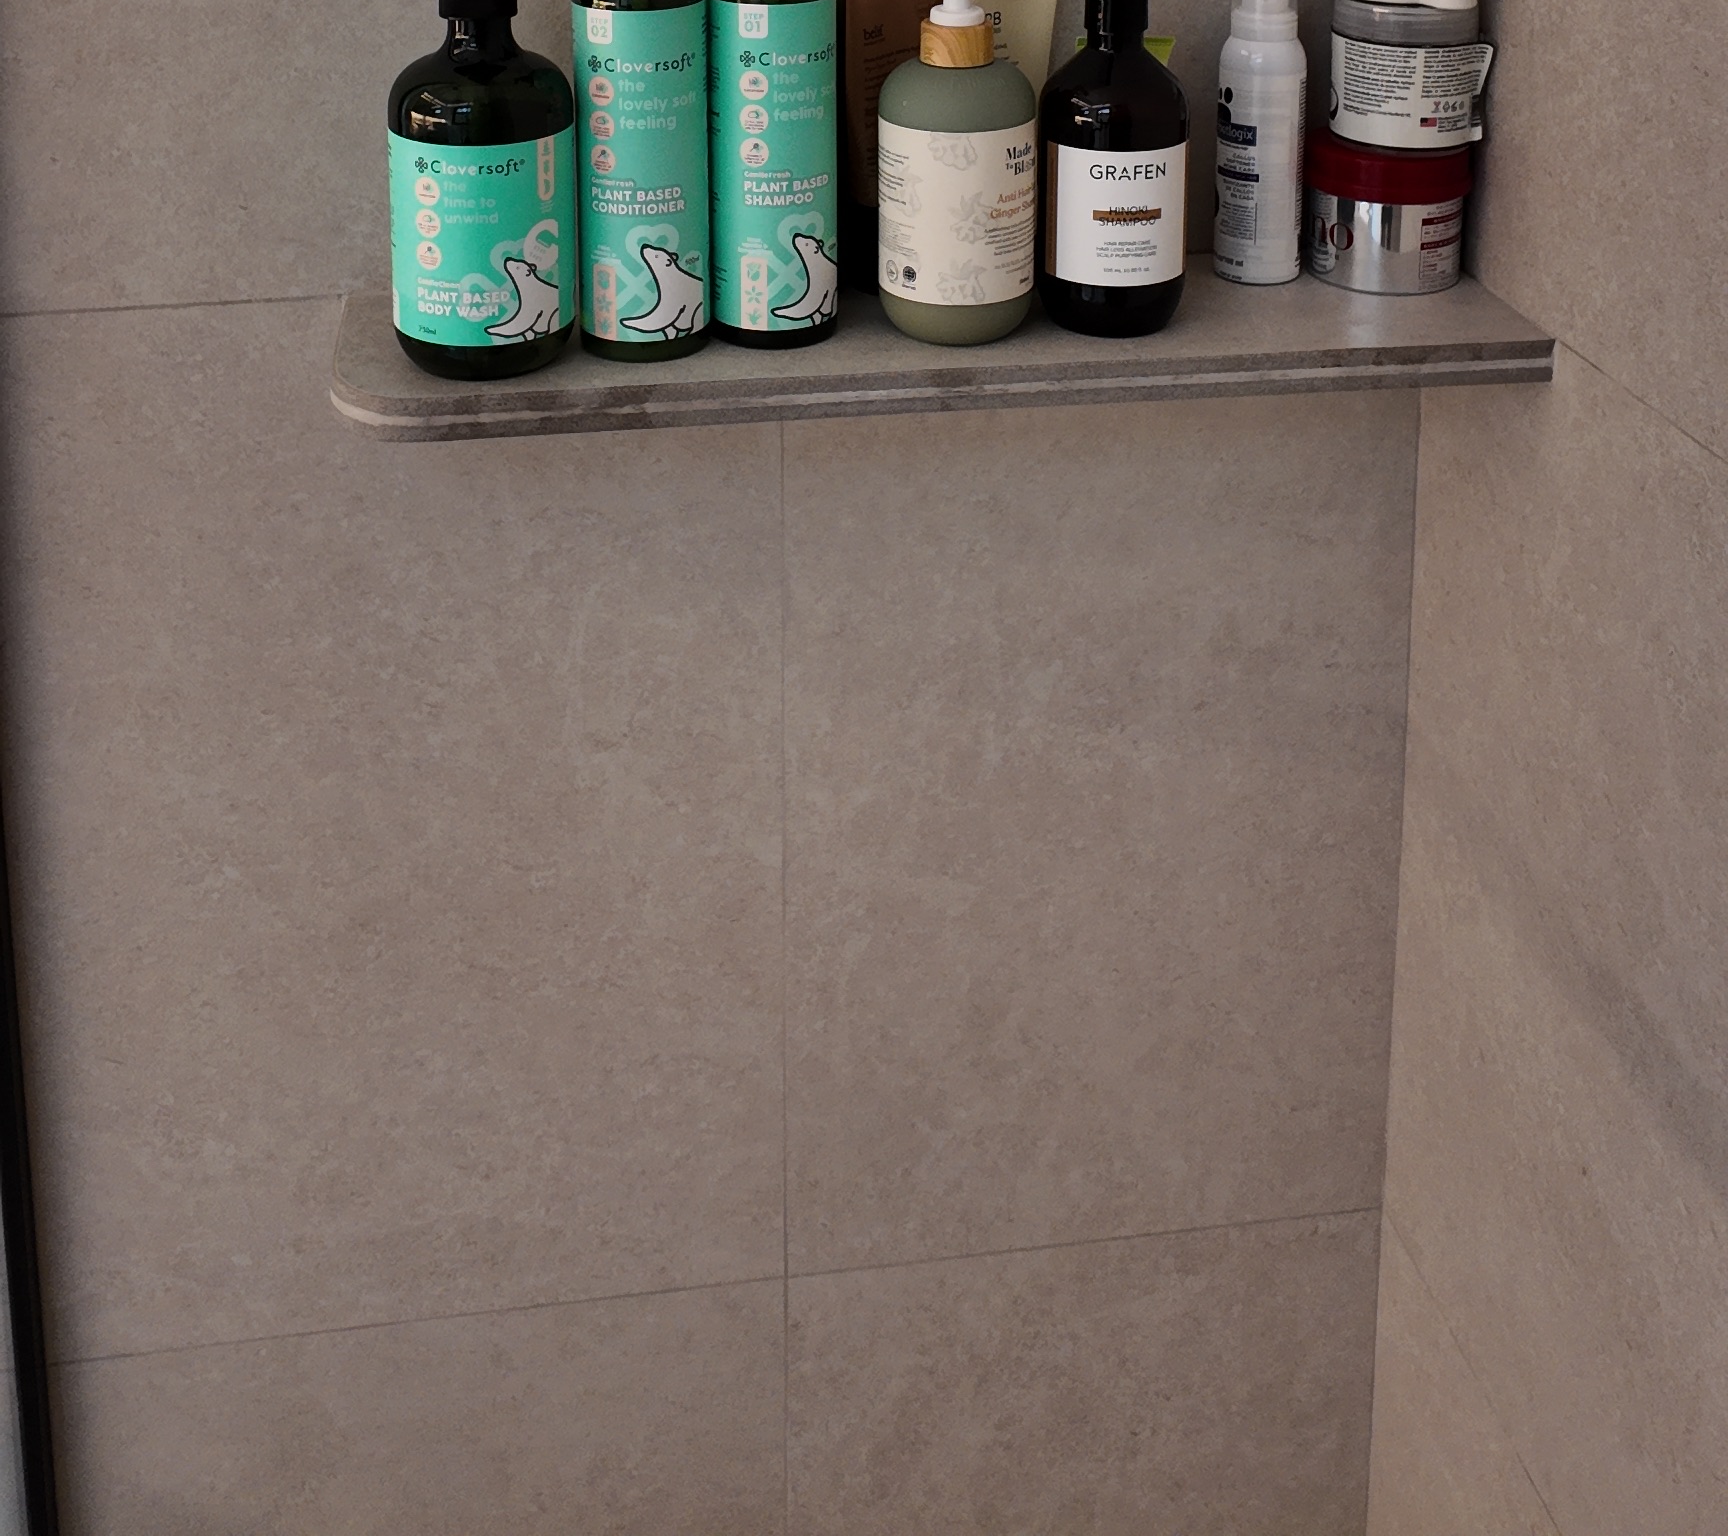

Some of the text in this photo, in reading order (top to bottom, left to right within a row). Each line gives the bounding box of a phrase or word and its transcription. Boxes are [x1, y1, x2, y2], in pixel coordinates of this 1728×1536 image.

[590, 25, 608, 38] 02
[744, 20, 761, 33] 01
[772, 71, 799, 85] the
[618, 79, 646, 93] the
[618, 90, 697, 113] lovely soft
[773, 86, 818, 104] lovely
[773, 105, 825, 122] feeling
[619, 114, 677, 131] feeling
[1005, 142, 1032, 162] Made
[1089, 162, 1167, 181] GRAFEN
[443, 179, 467, 193] the
[743, 174, 829, 193] PLANT BASED
[591, 186, 682, 202] PLANT BASED
[744, 191, 814, 206] SHAMPOO
[996, 190, 1017, 205] Anti
[443, 196, 476, 208] time
[479, 197, 497, 208] to
[591, 199, 685, 215] CONDITIONER
[443, 212, 499, 224] unwind
[989, 206, 1022, 219] Ginger
[1109, 205, 1148, 216] HINOKI
[1098, 215, 1157, 227] SHAMPOO
[417, 287, 511, 305] PLANT BASED
[417, 301, 499, 318] BODY WASH
